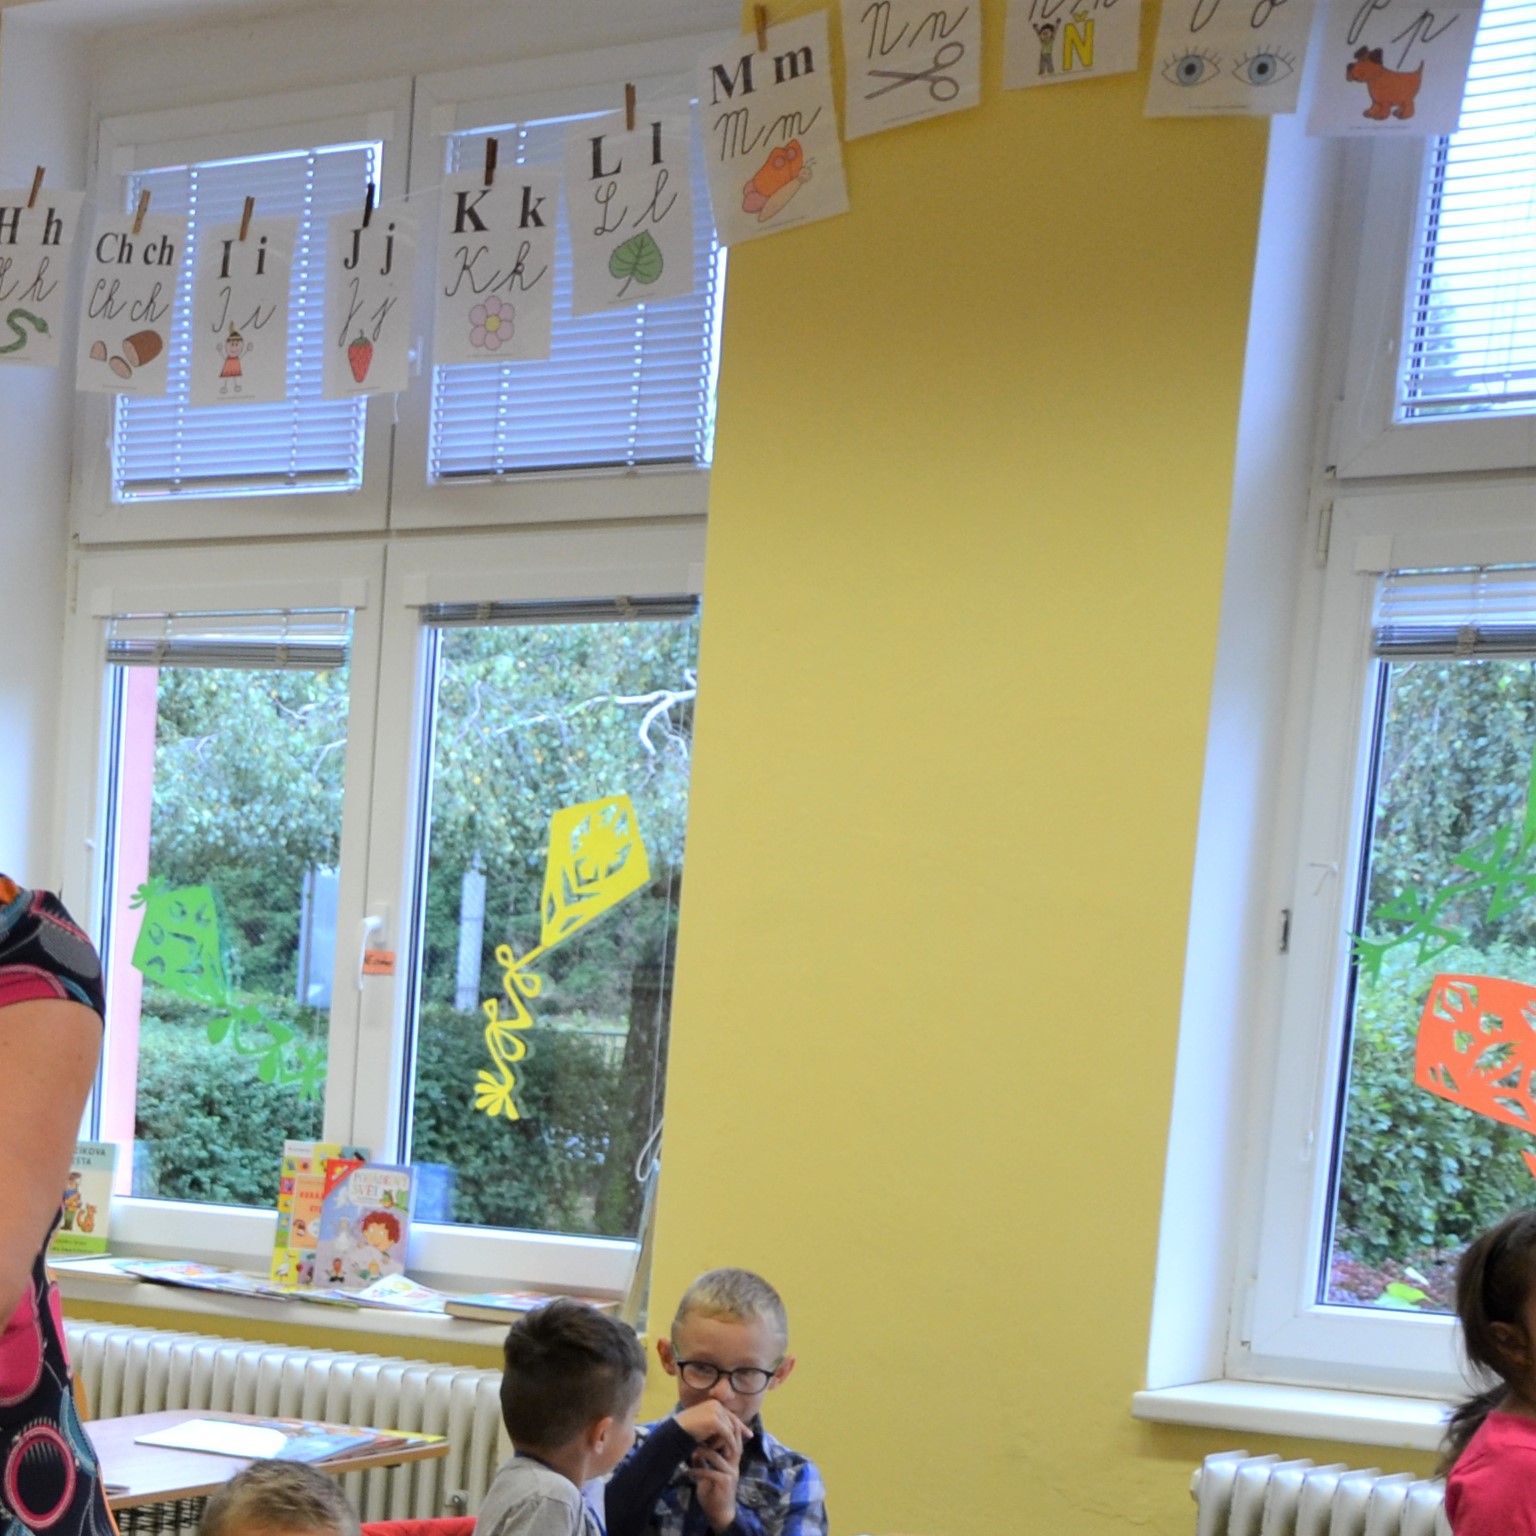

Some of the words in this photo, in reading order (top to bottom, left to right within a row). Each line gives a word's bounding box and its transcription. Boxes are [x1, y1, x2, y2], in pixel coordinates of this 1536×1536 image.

[709, 53, 757, 105] M
[772, 46, 815, 84] m
[588, 135, 623, 181] L
[42, 208, 64, 246] h
[451, 189, 491, 234] K
[517, 186, 547, 229] k
[96, 231, 134, 265] Ch
[143, 234, 174, 267] ch
[255, 235, 268, 276] i
[344, 228, 363, 271] J
[380, 222, 396, 277] j
